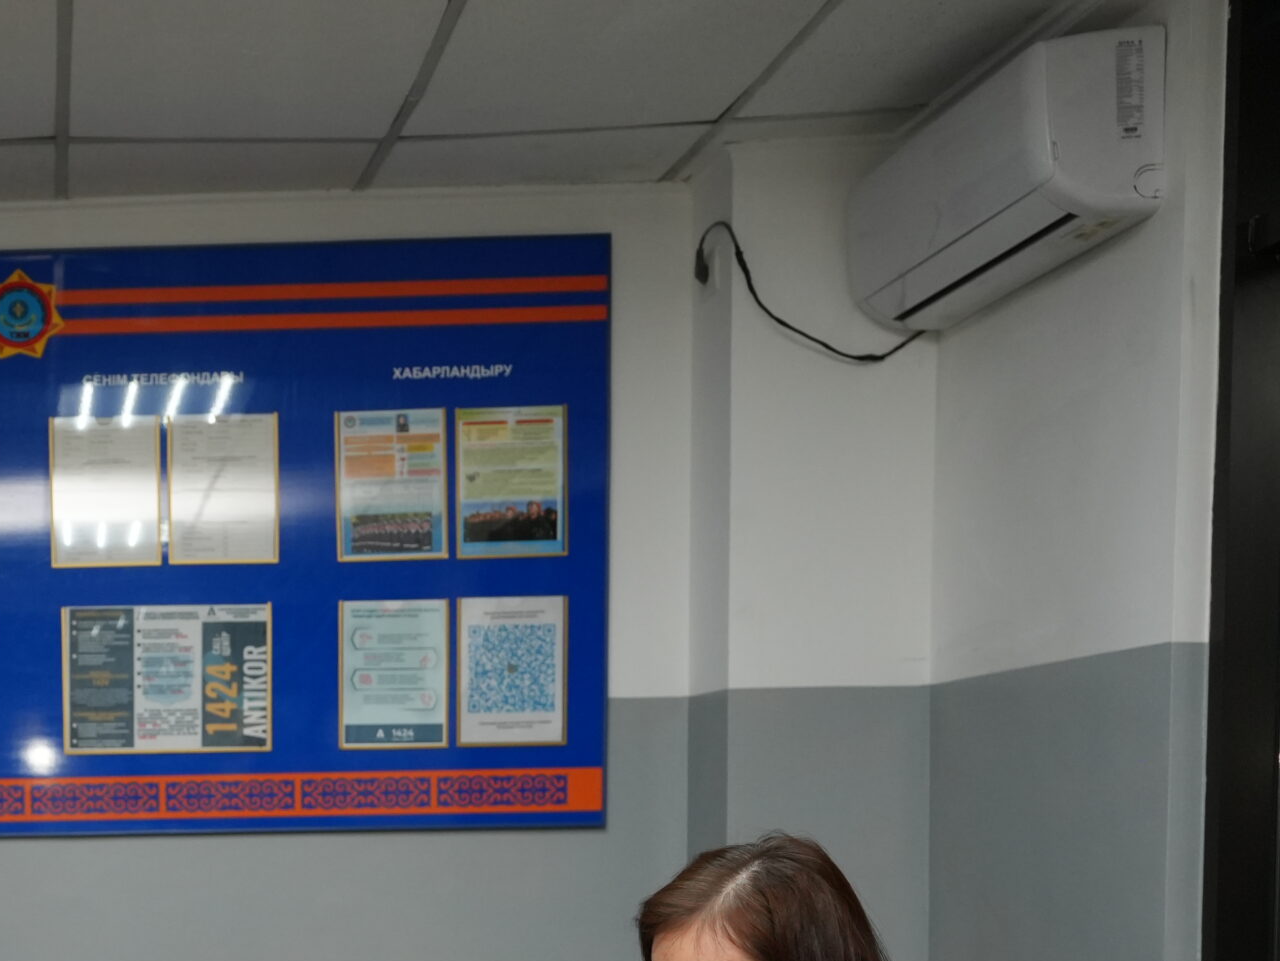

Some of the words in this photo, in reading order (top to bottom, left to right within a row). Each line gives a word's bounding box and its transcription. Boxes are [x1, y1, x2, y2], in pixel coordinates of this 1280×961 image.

[393, 364, 512, 379] ХАБАРЛАНДЫРУ
[205, 662, 238, 735] 1424
[242, 645, 267, 740] ANTIKOR
